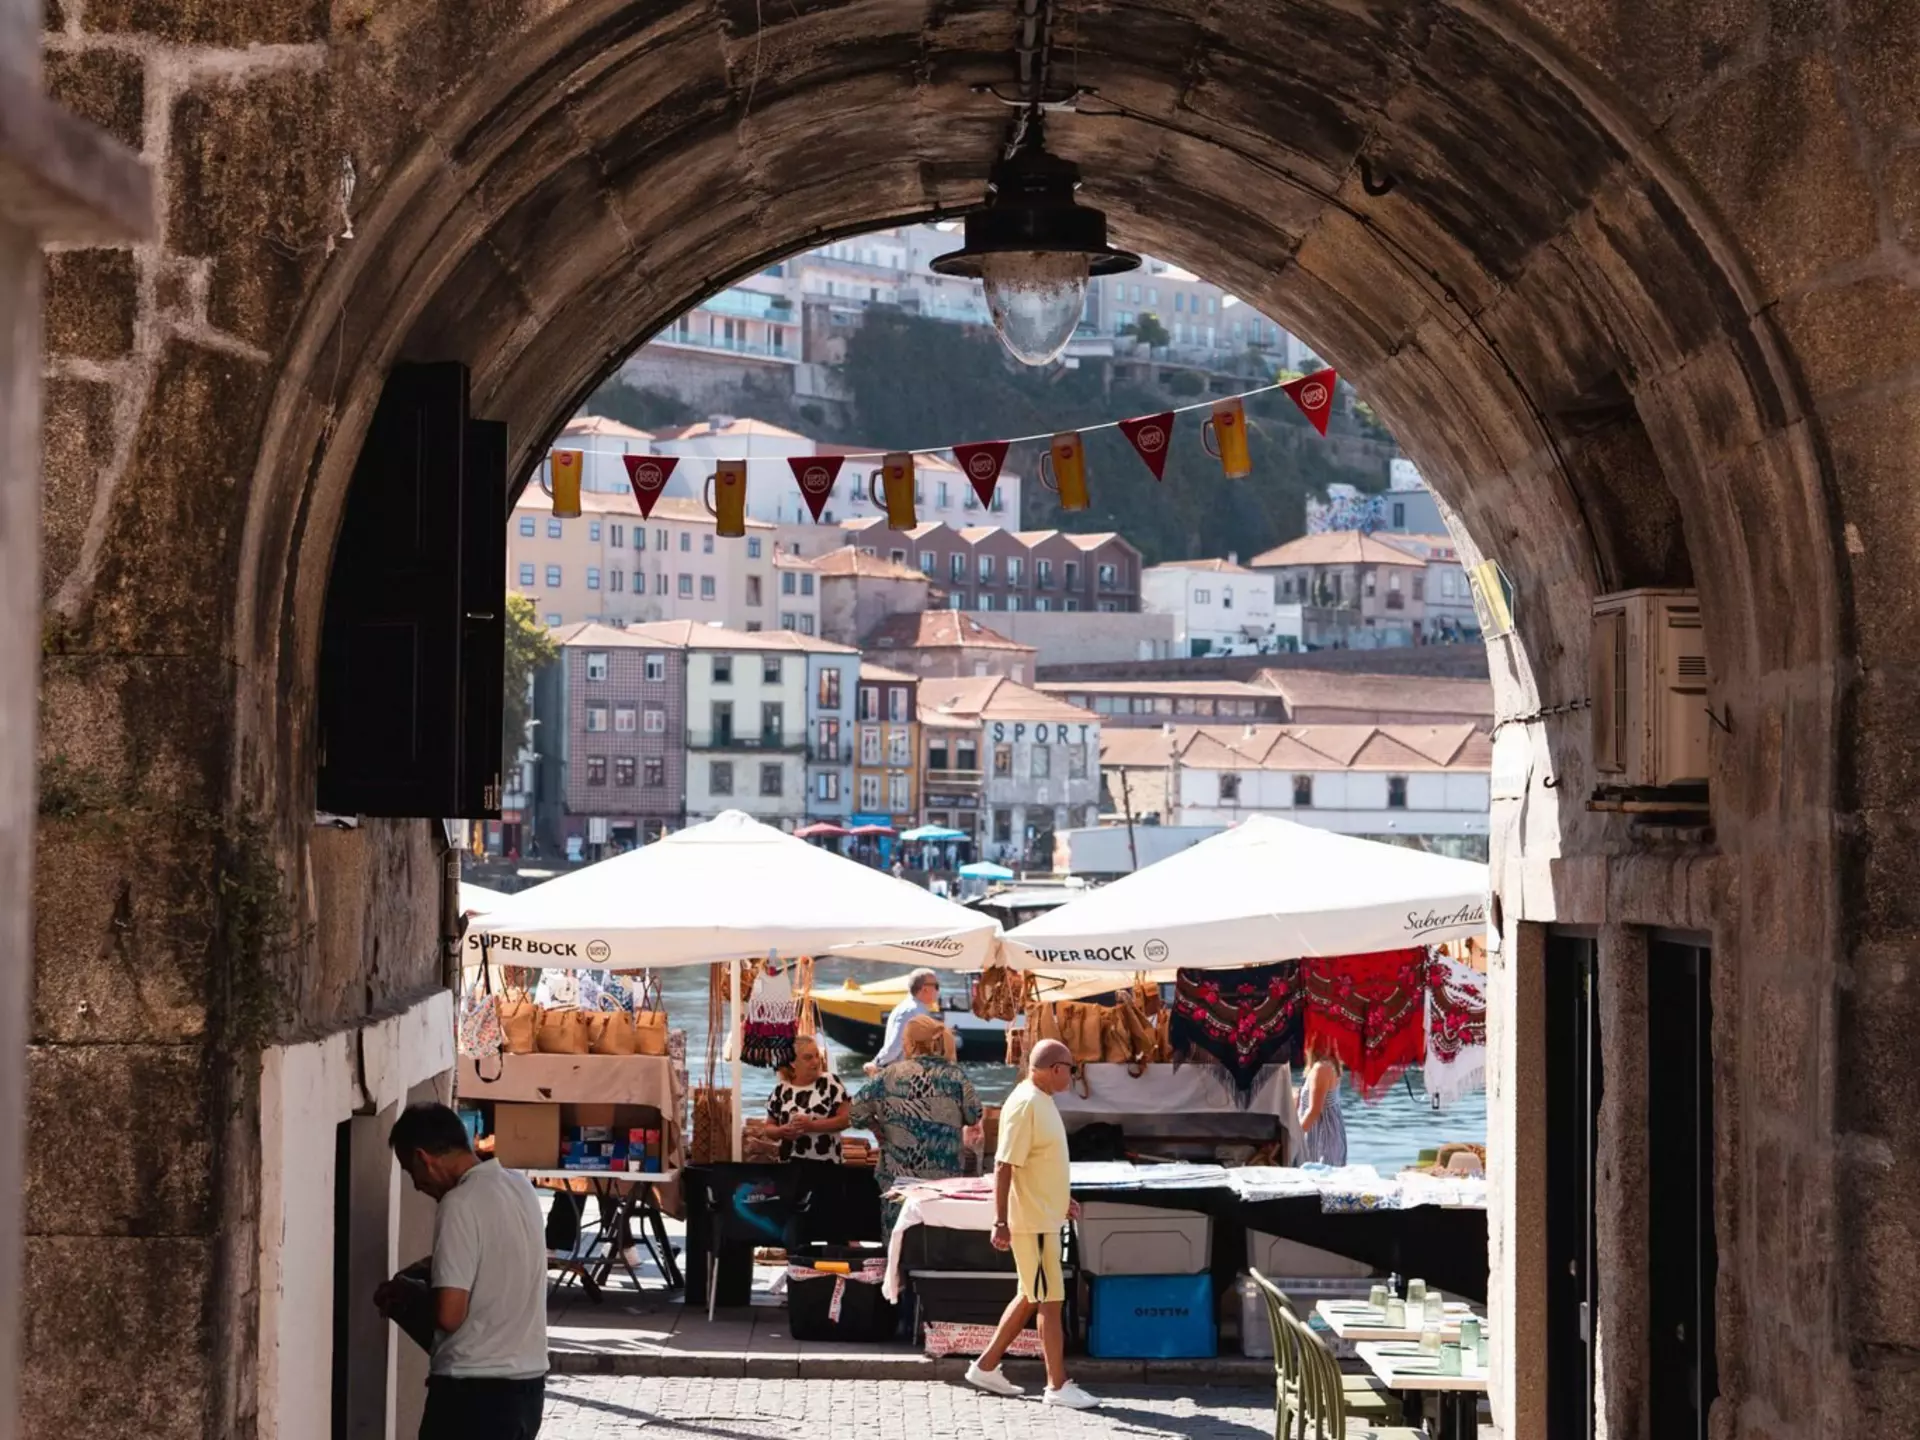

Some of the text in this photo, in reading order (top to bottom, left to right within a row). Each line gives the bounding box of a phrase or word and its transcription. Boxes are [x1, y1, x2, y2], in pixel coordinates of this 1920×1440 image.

[1303, 388, 1323, 398] SUPER
[1140, 431, 1161, 440] SUPER
[1404, 910, 1450, 930] Sabor
[526, 940, 578, 957] BOCK
[1083, 945, 1136, 961] BOCK
